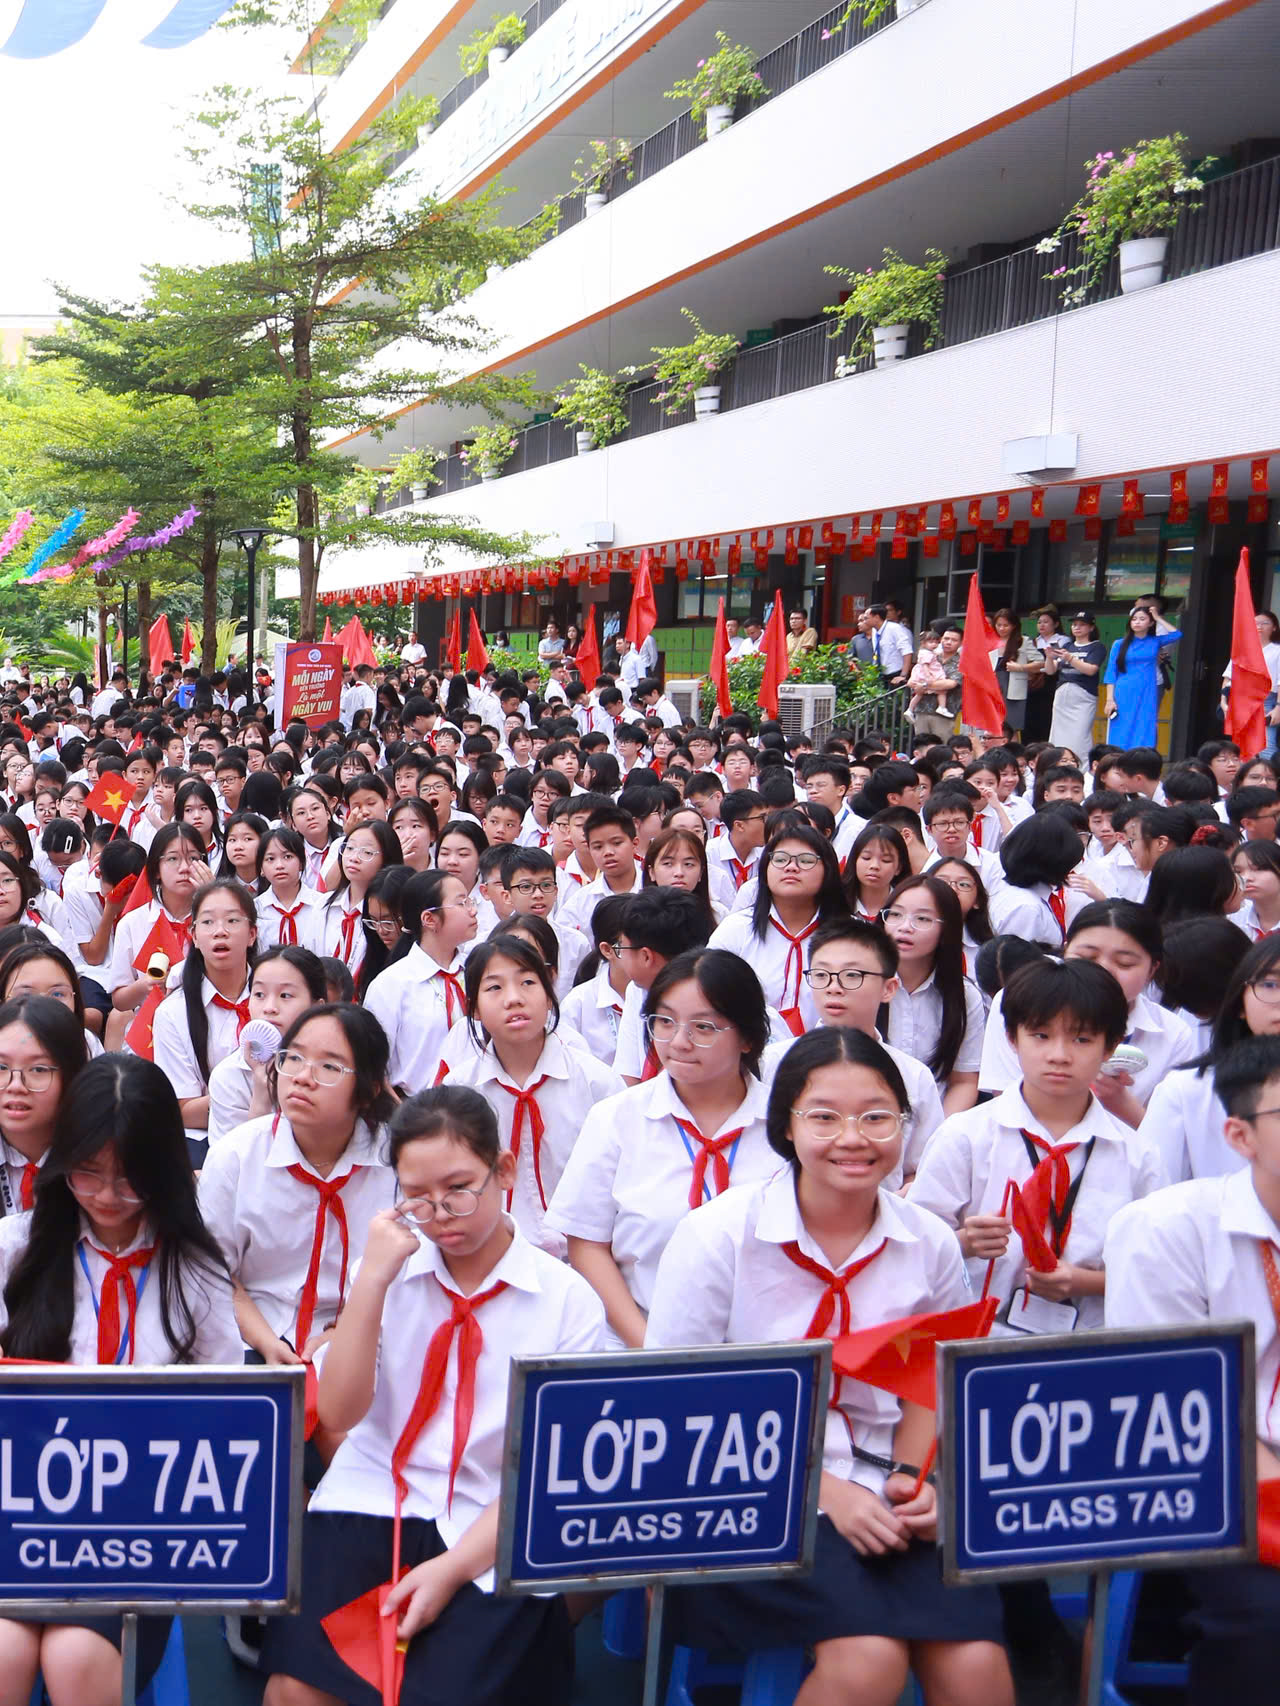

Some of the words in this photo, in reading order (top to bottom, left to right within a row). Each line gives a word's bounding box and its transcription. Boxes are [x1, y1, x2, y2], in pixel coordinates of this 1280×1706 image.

[310, 668, 335, 684] NGÀY
[291, 702, 316, 717] NGÀY
[317, 700, 333, 713] VUI
[546, 1399, 667, 1494] LỚP
[685, 1410, 782, 1486] 7A8
[979, 1383, 1093, 1480] LỚP
[1110, 1390, 1211, 1467] 7A9
[1, 1417, 129, 1514] LỚP
[148, 1439, 260, 1513] 7A7
[560, 1512, 682, 1547] CLASS
[695, 1507, 758, 1537] 7A8
[995, 1494, 1117, 1533] CLASS
[1128, 1489, 1195, 1522] 7A9
[19, 1538, 153, 1568] CLASS
[166, 1539, 238, 1568] 7A7
